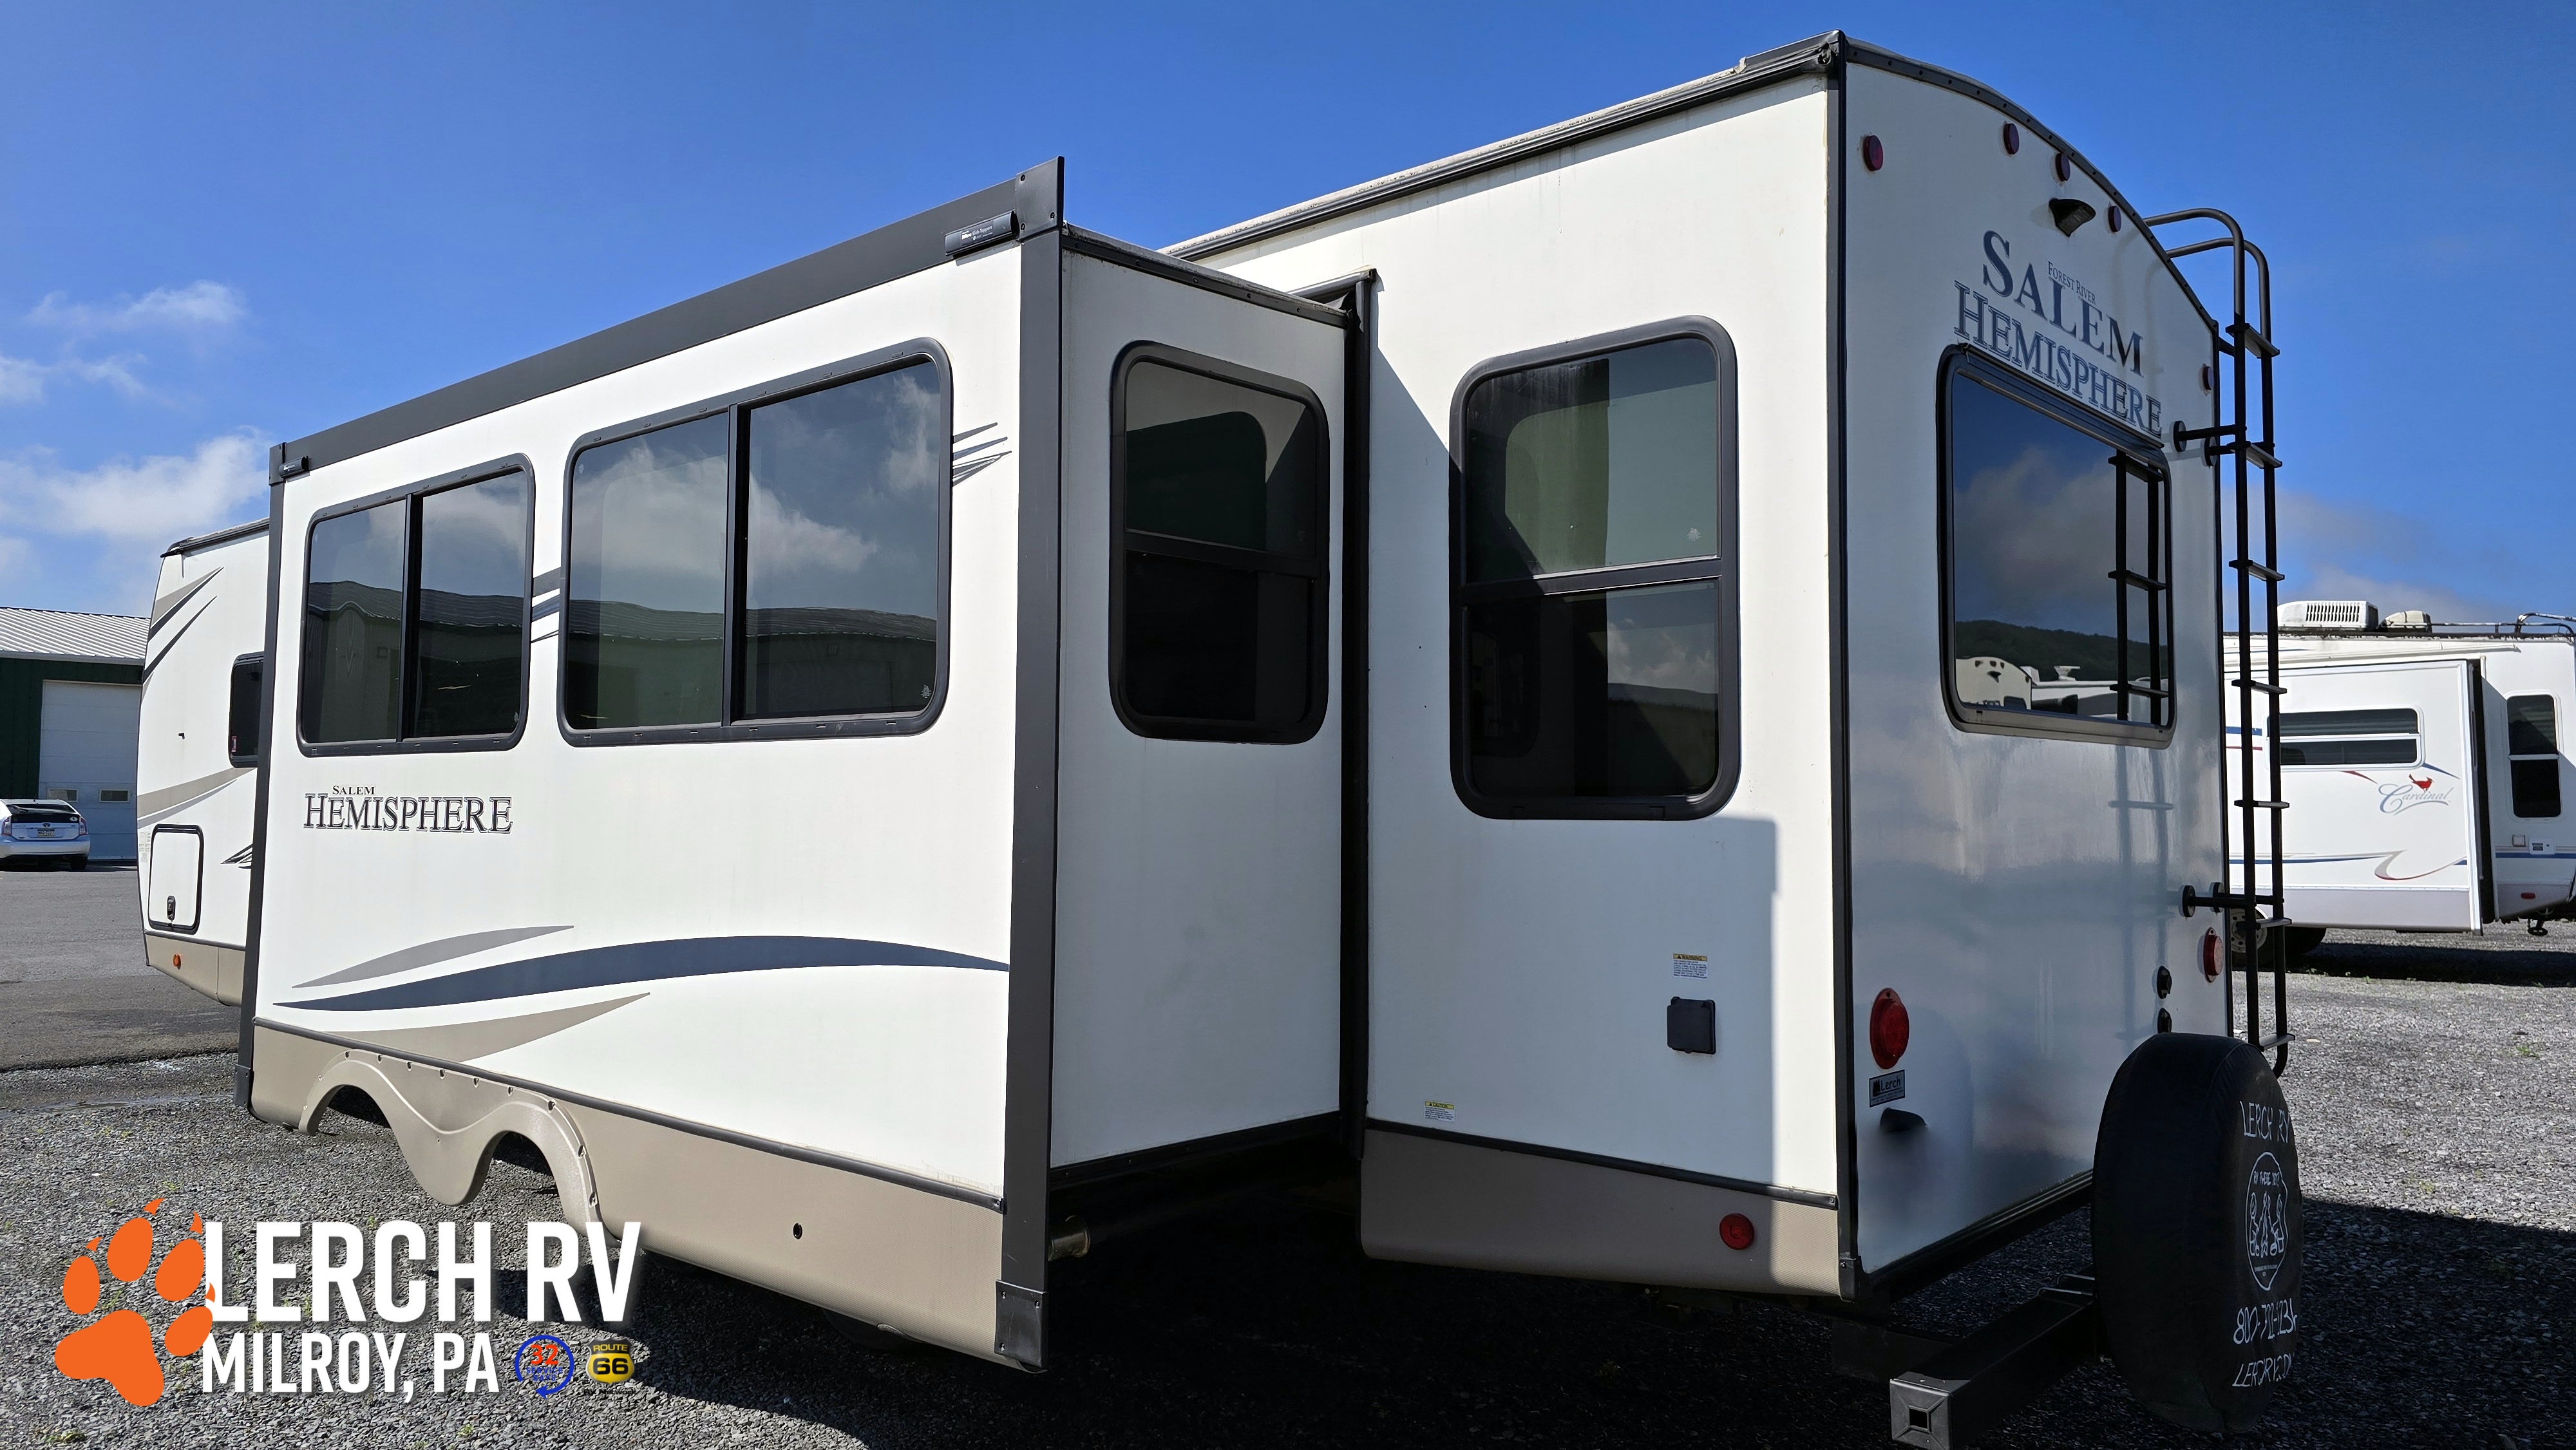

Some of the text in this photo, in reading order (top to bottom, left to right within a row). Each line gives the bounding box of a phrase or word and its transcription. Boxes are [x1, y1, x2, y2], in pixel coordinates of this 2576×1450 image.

[1982, 230, 2144, 378] SALEM
[2047, 260, 2097, 306] FOREST RIVER
[1954, 279, 2163, 438] HEMISPHERE
[332, 785, 376, 795] SALEM
[2378, 783, 2454, 814] Cardinal
[303, 793, 513, 834] HEMISPHERE
[1880, 1075, 1901, 1091] Lerch
[2240, 1100, 2290, 1144] LERCH RV
